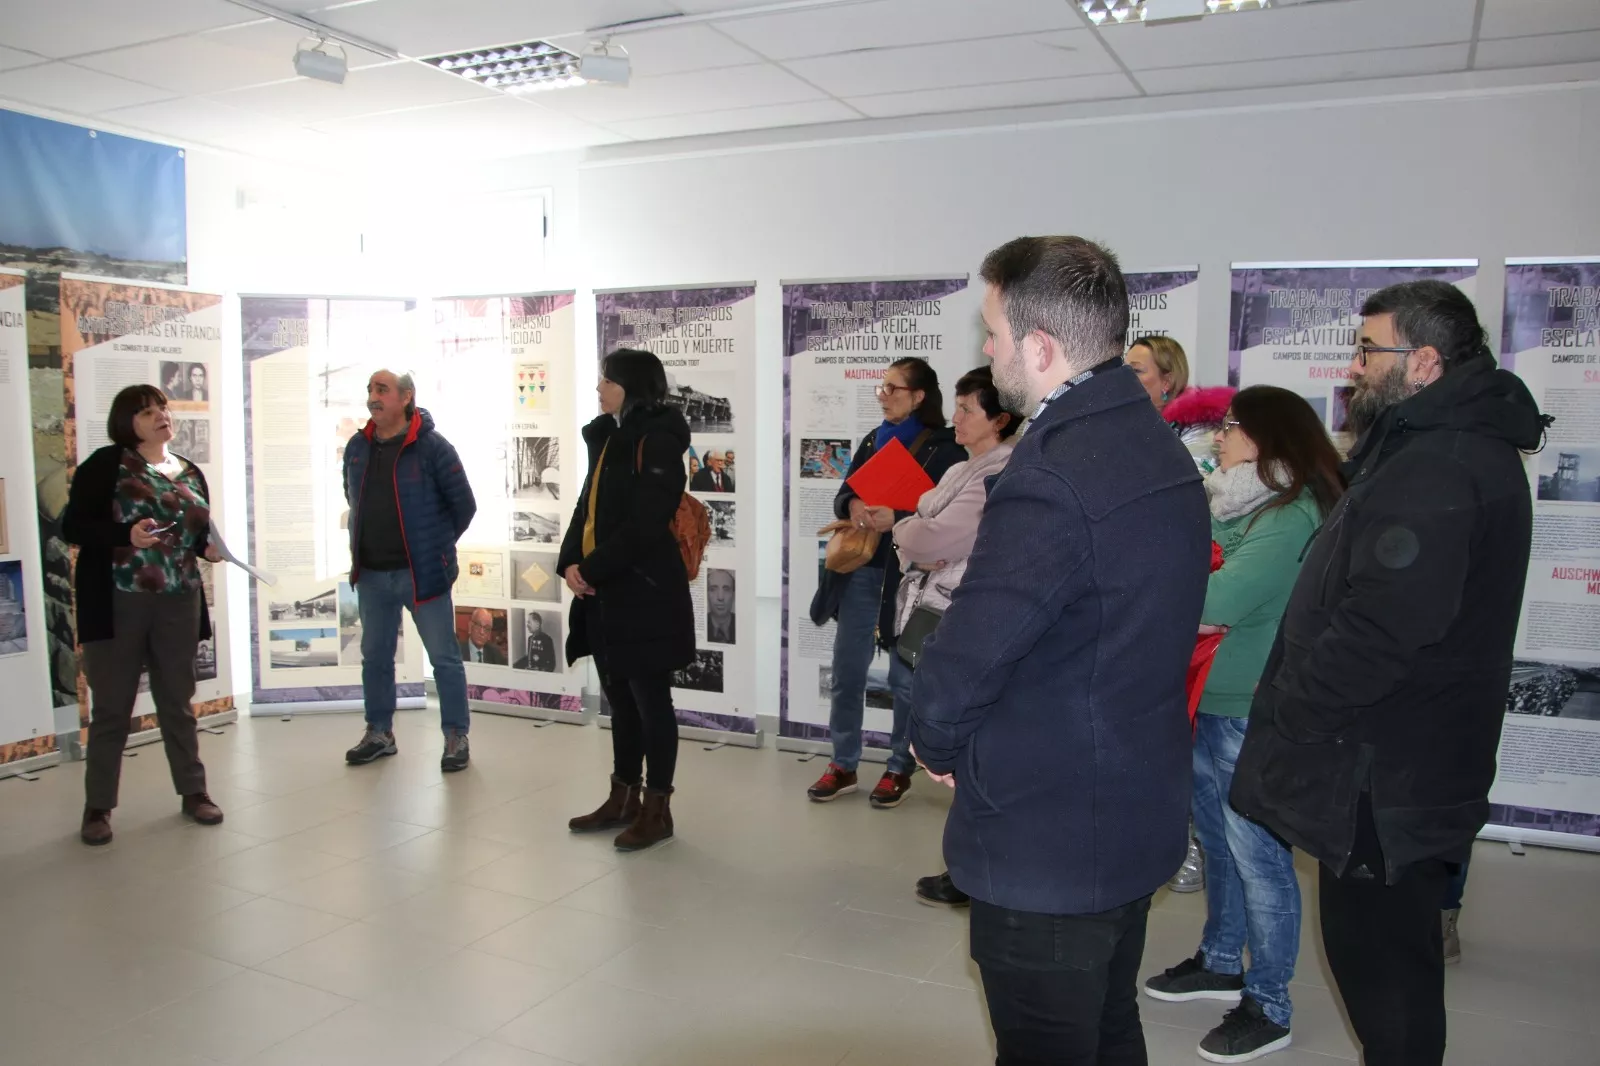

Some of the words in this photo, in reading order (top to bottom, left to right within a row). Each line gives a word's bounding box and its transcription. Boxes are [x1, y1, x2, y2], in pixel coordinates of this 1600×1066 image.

[1269, 288, 1351, 308] TRABAJOS
[620, 308, 675, 325] TRABAJOS
[676, 306, 733, 323] FORZADOS
[810, 300, 874, 319] TRABAJOS
[876, 300, 941, 318] FORZADOS
[1291, 308, 1333, 327] PARA
[1338, 308, 1356, 327] EL
[1573, 307, 1600, 327] PA
[509, 315, 551, 329] NALISMO
[827, 318, 860, 335] PARA
[863, 318, 877, 334] EL
[881, 318, 920, 333] REICH.
[164, 324, 178, 338] EN
[180, 326, 221, 341] FRANCIA
[510, 331, 542, 345] ICIDAD
[636, 324, 663, 340] PARA
[666, 324, 677, 338] EL
[1263, 327, 1357, 345] ESCLAVITUD
[1541, 328, 1600, 347] ESCLA
[683, 340, 689, 354] Y
[693, 339, 735, 353] MUERTE
[807, 335, 879, 351] ESCLAVITUD
[883, 335, 890, 350] Y
[895, 334, 942, 350] MUERTE
[815, 356, 837, 364] CAMPOS
[838, 356, 845, 364] DE
[846, 355, 890, 364] CONCENTRACIÓN
[1272, 352, 1302, 360] CAMPOS
[1303, 352, 1312, 360] DE
[1313, 352, 1357, 361] CONCENTRA
[1552, 354, 1585, 364] CAMPOS
[1586, 354, 1597, 364] DE
[844, 368, 887, 380] MAUTHAUS
